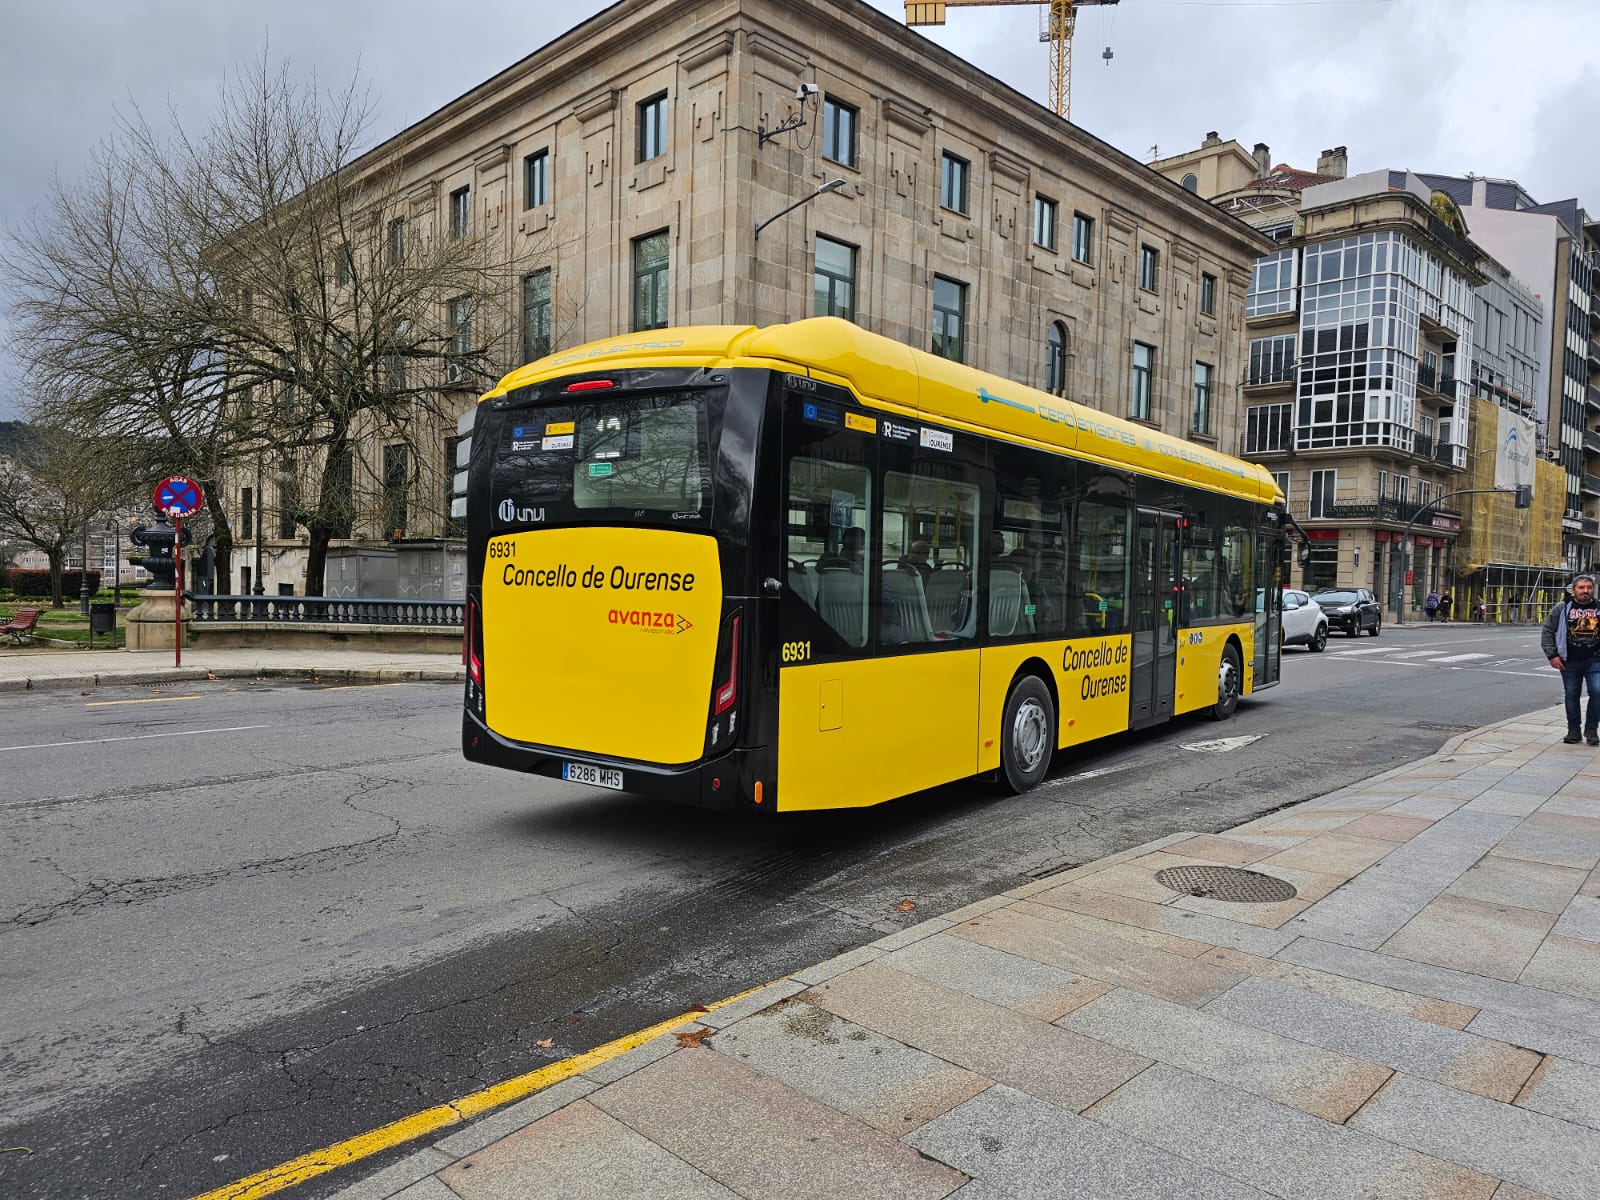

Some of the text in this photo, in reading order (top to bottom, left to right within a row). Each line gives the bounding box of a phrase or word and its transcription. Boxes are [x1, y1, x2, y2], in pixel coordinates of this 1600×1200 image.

[489, 541, 516, 558] 6931
[503, 563, 695, 592] Concello de Ourense
[608, 609, 674, 627] avanza
[782, 640, 811, 662] 6931
[1062, 639, 1128, 672] Concello de
[1081, 674, 1127, 701] Ourense
[570, 765, 620, 787] 6286 MHS
